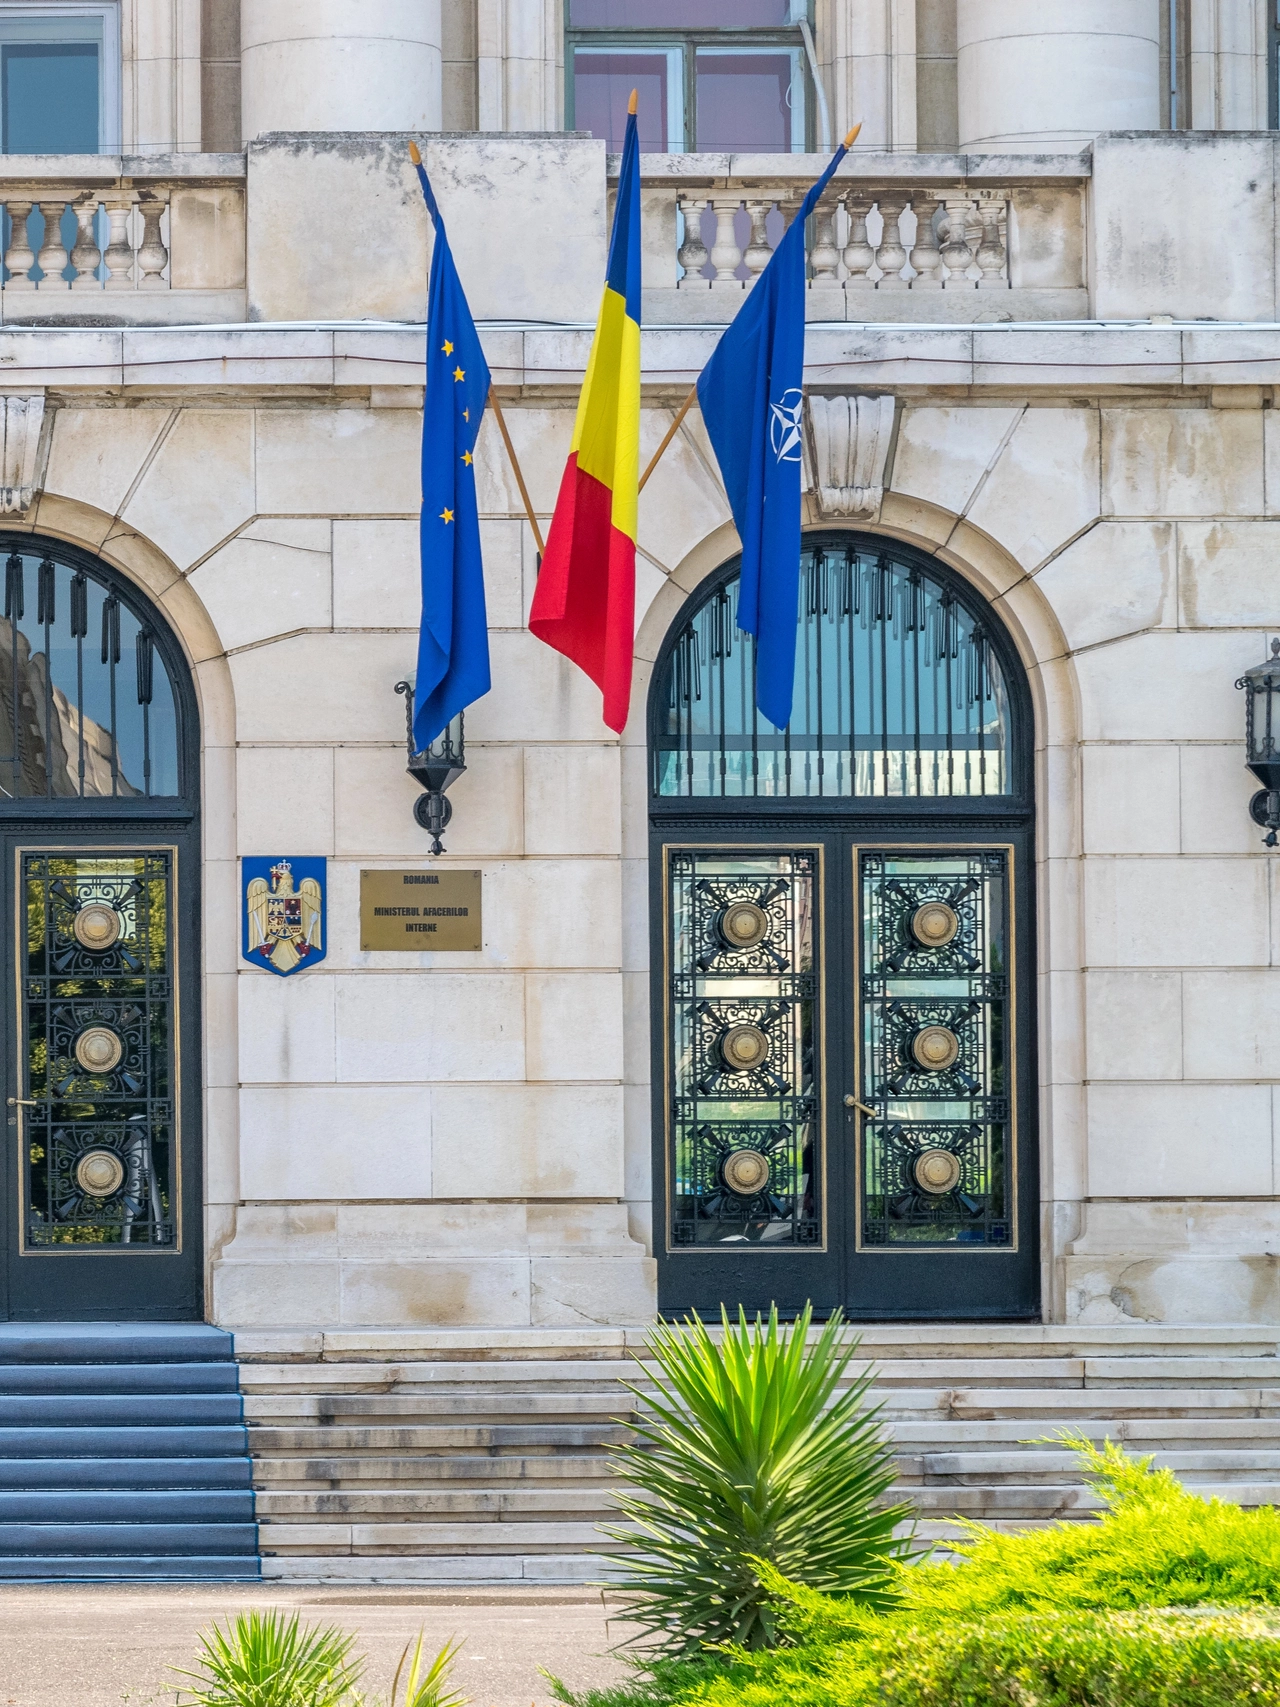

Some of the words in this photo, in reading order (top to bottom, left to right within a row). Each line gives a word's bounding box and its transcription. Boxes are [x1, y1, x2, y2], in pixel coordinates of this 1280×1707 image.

[403, 875, 439, 885] ROMANIA
[374, 907, 420, 917] MINISTERUL
[423, 907, 469, 917] AFACERILOR
[405, 923, 438, 933] INTERNE
